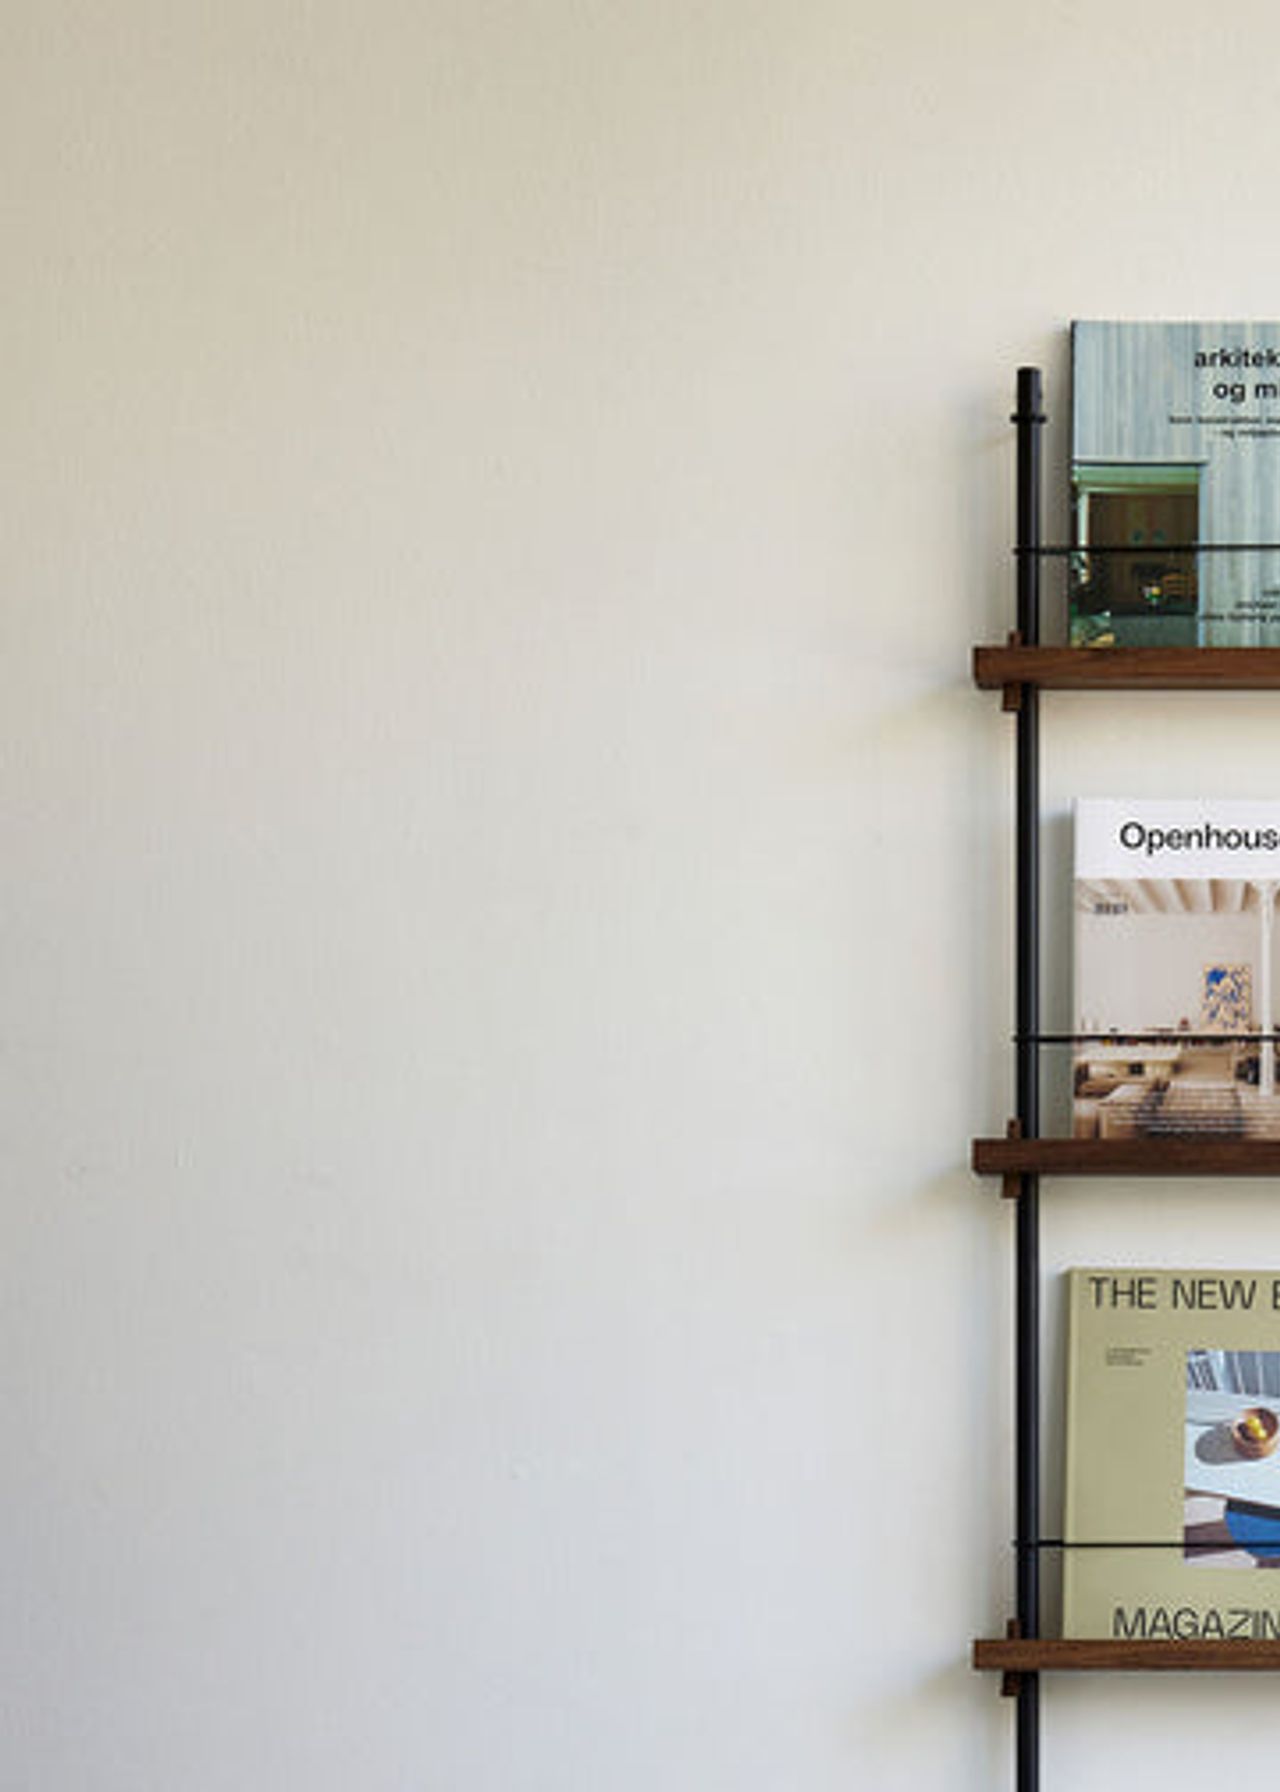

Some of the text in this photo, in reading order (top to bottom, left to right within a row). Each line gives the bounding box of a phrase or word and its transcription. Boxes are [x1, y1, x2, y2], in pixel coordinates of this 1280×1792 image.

[1213, 382, 1246, 402] og
[1088, 1276, 1157, 1310] THE
[1172, 1279, 1257, 1311] NEW
